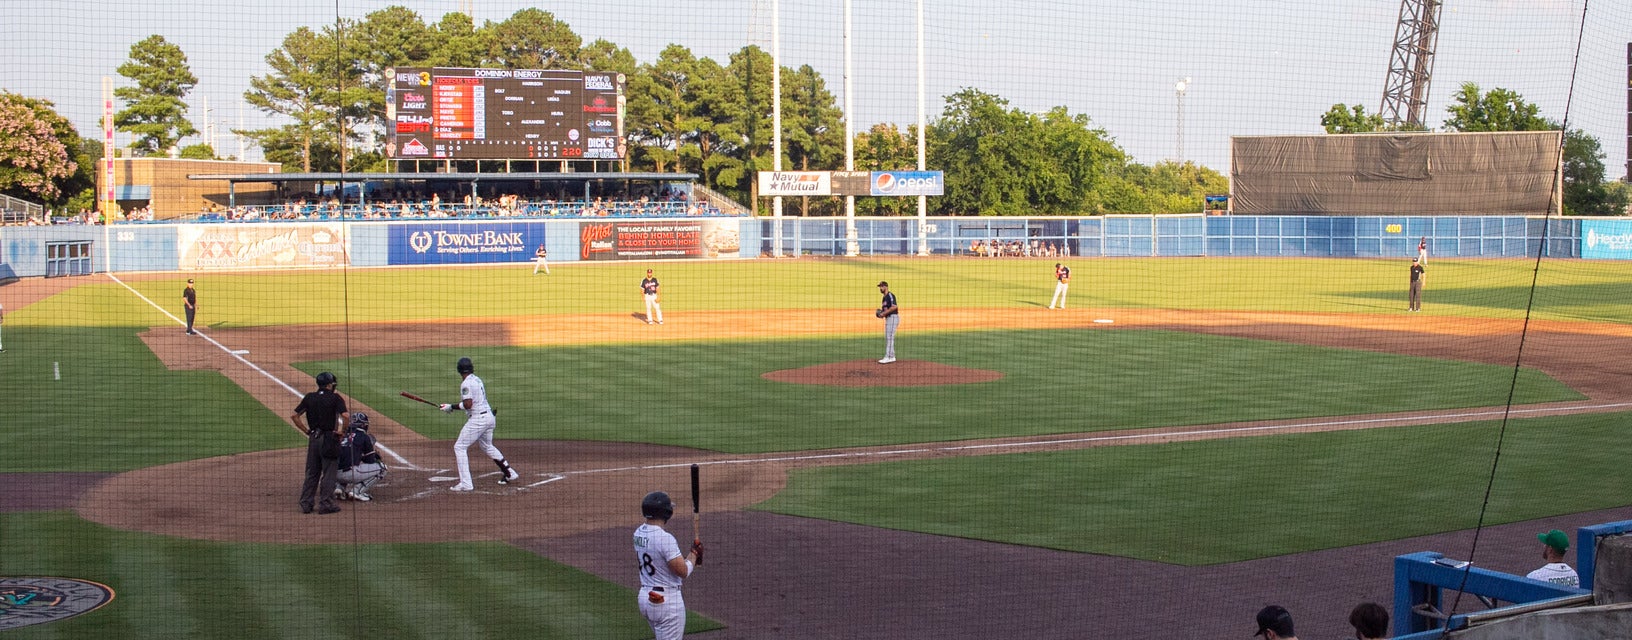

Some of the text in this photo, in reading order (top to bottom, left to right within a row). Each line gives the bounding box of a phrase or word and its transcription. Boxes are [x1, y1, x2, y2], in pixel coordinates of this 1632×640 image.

[397, 71, 430, 86] NEWS 3
[396, 123, 429, 132] ESPN
[588, 138, 614, 148] DICK'S
[772, 173, 799, 183] Navy
[897, 175, 937, 189] pepsi
[780, 182, 819, 191] Mutual
[920, 224, 937, 233] 375
[1385, 224, 1402, 233] 400
[117, 231, 134, 241] 333
[200, 241, 233, 258] XX
